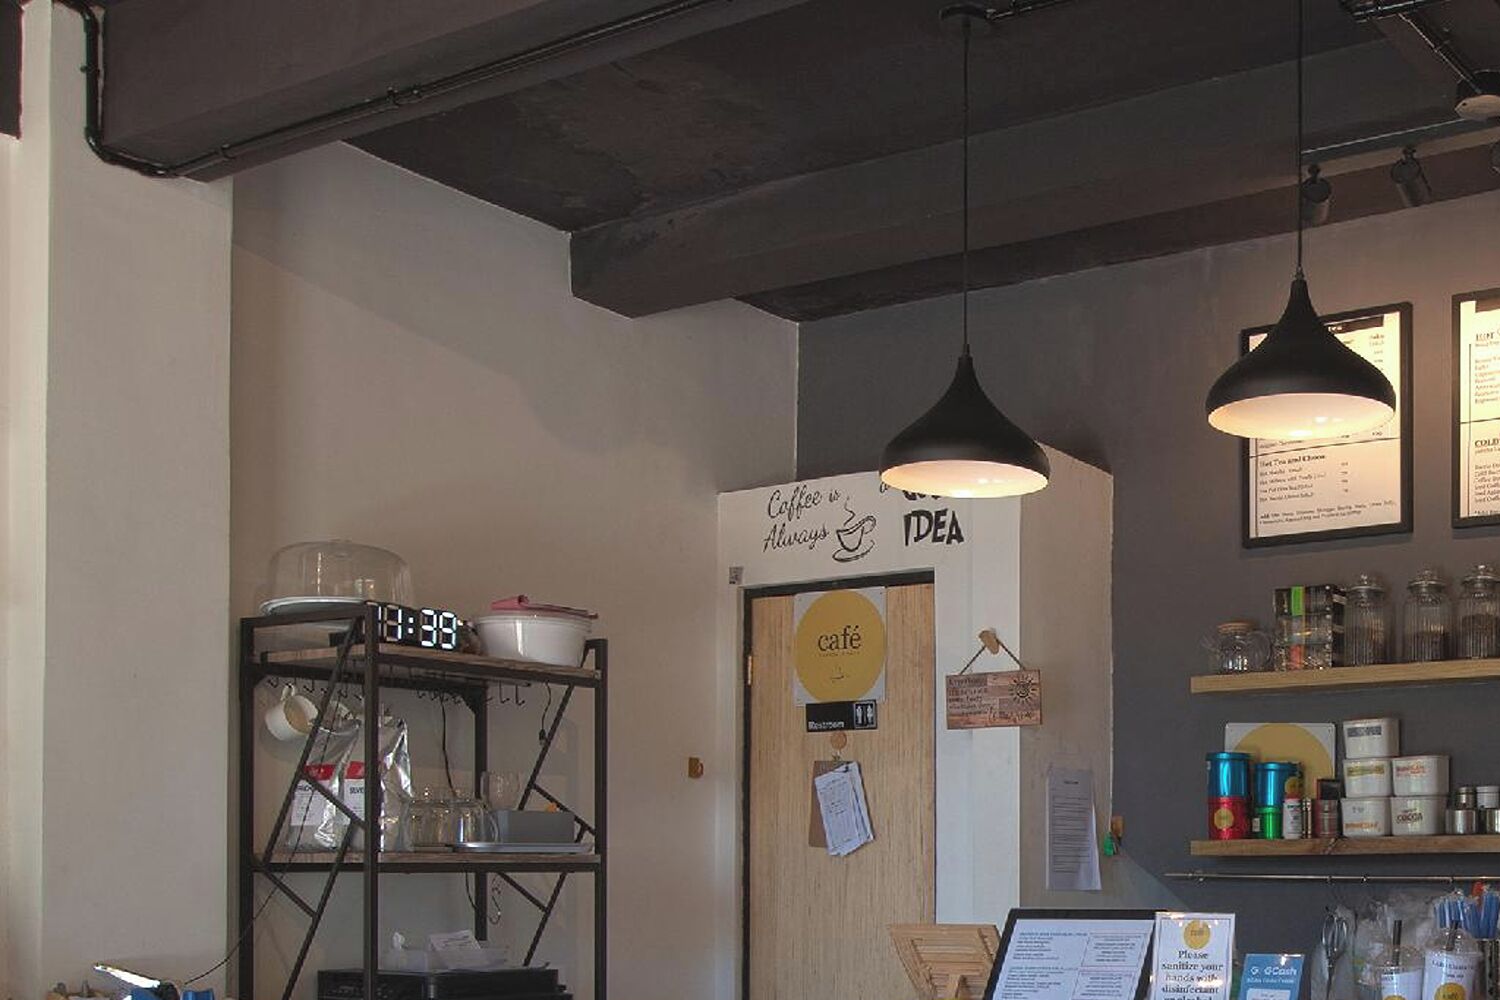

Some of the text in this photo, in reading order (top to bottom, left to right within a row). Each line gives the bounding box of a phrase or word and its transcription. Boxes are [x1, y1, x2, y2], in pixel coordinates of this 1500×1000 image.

[1474, 438, 1500, 448] COLD
[767, 482, 842, 520] Coffee is
[903, 508, 965, 547] IDEA
[763, 522, 831, 553] Always
[817, 624, 862, 652] café
[808, 720, 845, 731] Restroom
[1178, 950, 1209, 960] Please
[1161, 961, 1224, 973] sanitize your
[1264, 966, 1298, 976] GCash
[1165, 973, 1195, 982] hands
[1162, 984, 1219, 994] disinfectant
